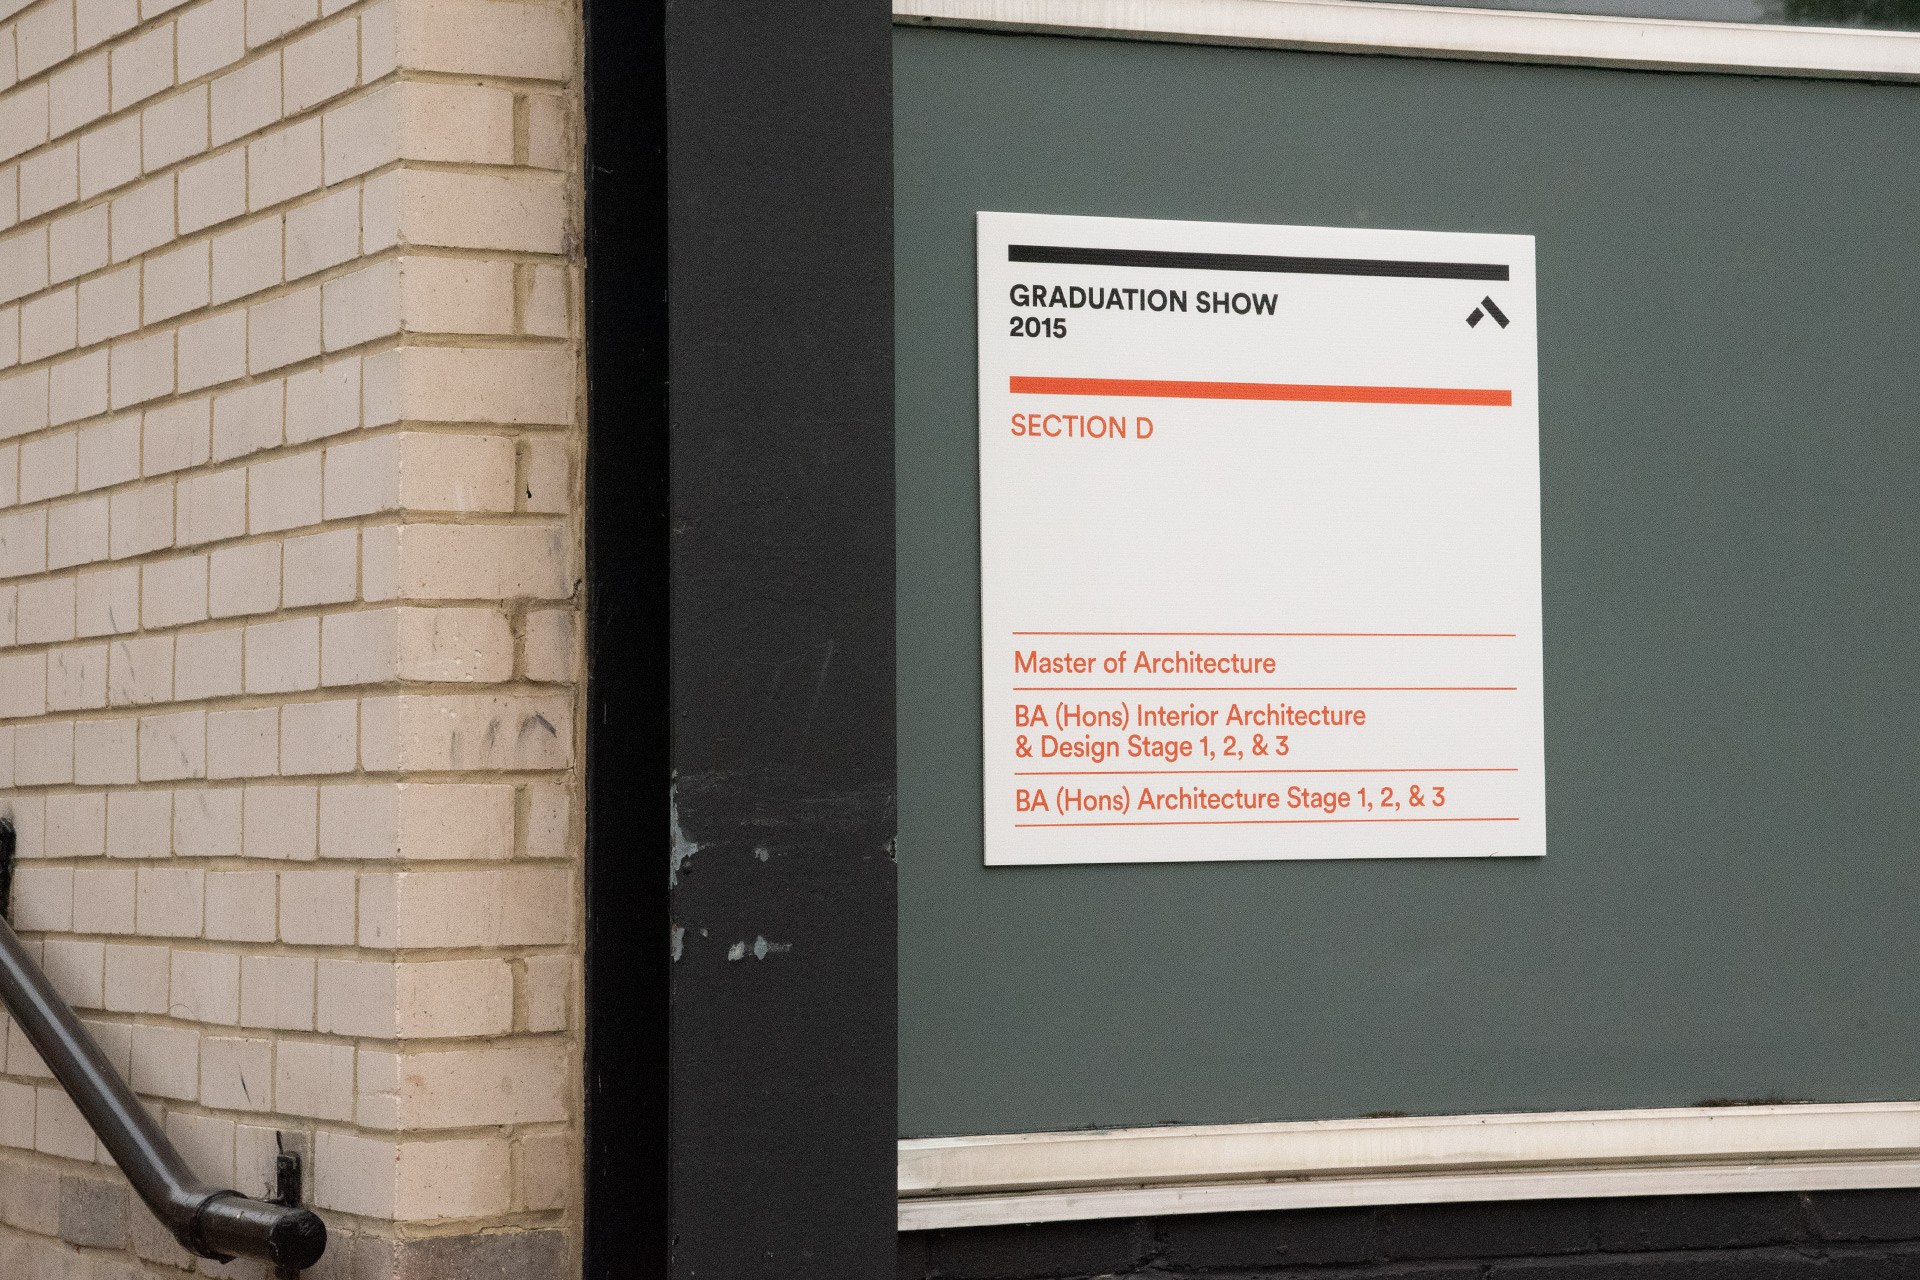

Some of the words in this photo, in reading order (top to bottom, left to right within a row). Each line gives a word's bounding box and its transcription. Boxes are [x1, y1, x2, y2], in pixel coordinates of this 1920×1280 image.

[1009, 283, 1188, 313] GRADUATION
[1195, 290, 1279, 316] SHOW
[1009, 315, 1068, 339] 2015
[1010, 412, 1127, 439] SECTION
[1136, 416, 1154, 440] D
[1014, 650, 1097, 674] Master
[1103, 650, 1127, 674] of
[1133, 650, 1277, 674] Architecture
[1015, 704, 1049, 728] BA
[1055, 701, 1130, 732] (Hons)
[1137, 702, 1219, 728] Interior
[1225, 702, 1366, 727] Architecture
[1015, 734, 1034, 759] &
[1041, 733, 1120, 764] Design
[1127, 733, 1193, 763] Stage
[1199, 735, 1216, 761] 1,
[1223, 735, 1244, 761] 2,
[1251, 733, 1269, 757] &
[1275, 735, 1290, 757] 3
[1016, 788, 1050, 812] BA
[1056, 785, 1131, 816] (Hons)
[1136, 786, 1280, 811] Architecture
[1286, 785, 1351, 814] Stage
[1357, 787, 1373, 812] 1,
[1380, 786, 1401, 812] 2,
[1408, 784, 1426, 808] &
[1431, 786, 1446, 808] 3
